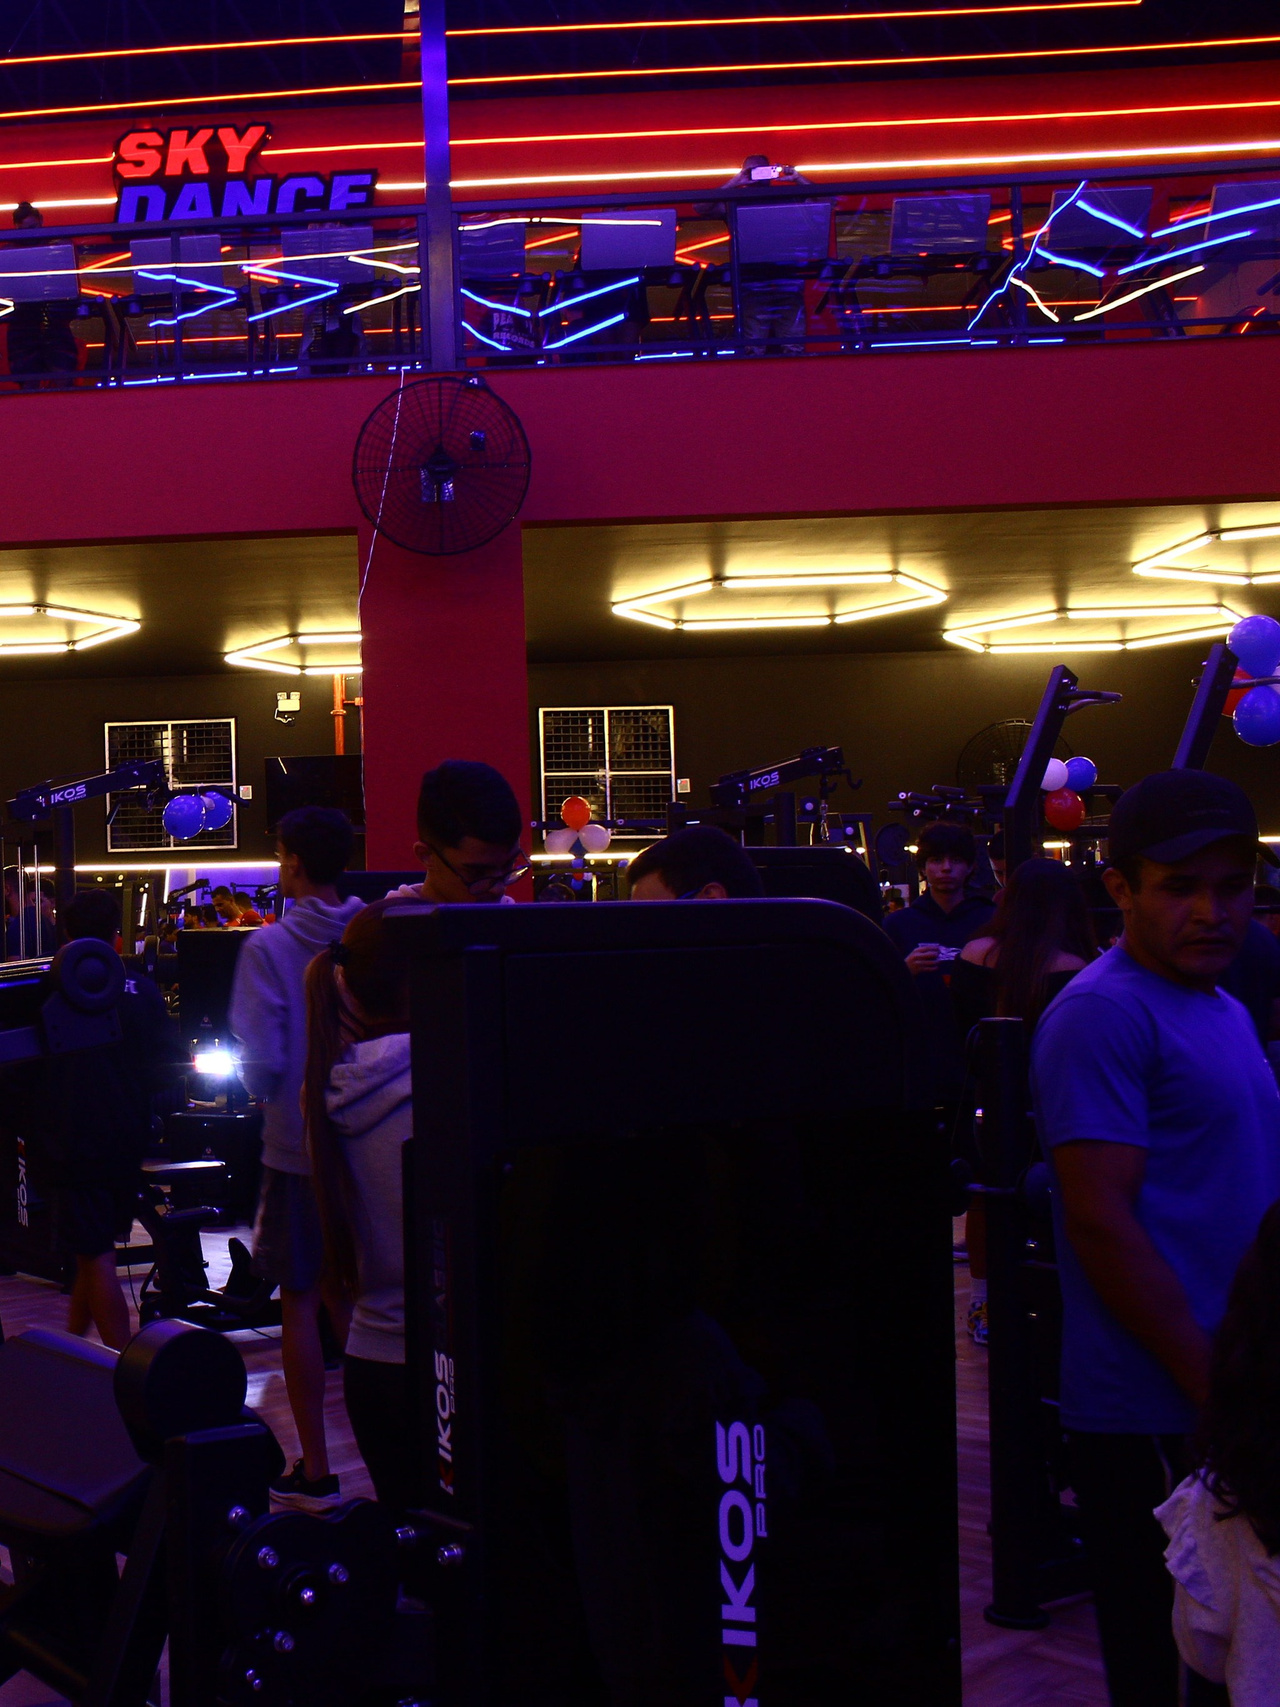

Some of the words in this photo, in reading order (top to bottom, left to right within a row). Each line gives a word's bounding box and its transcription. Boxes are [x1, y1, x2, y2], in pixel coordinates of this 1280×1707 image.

[116, 125, 267, 178] SKY
[118, 173, 373, 224] DANCE
[433, 1349, 455, 1497] KIKOS
[753, 1423, 768, 1539] PRO
